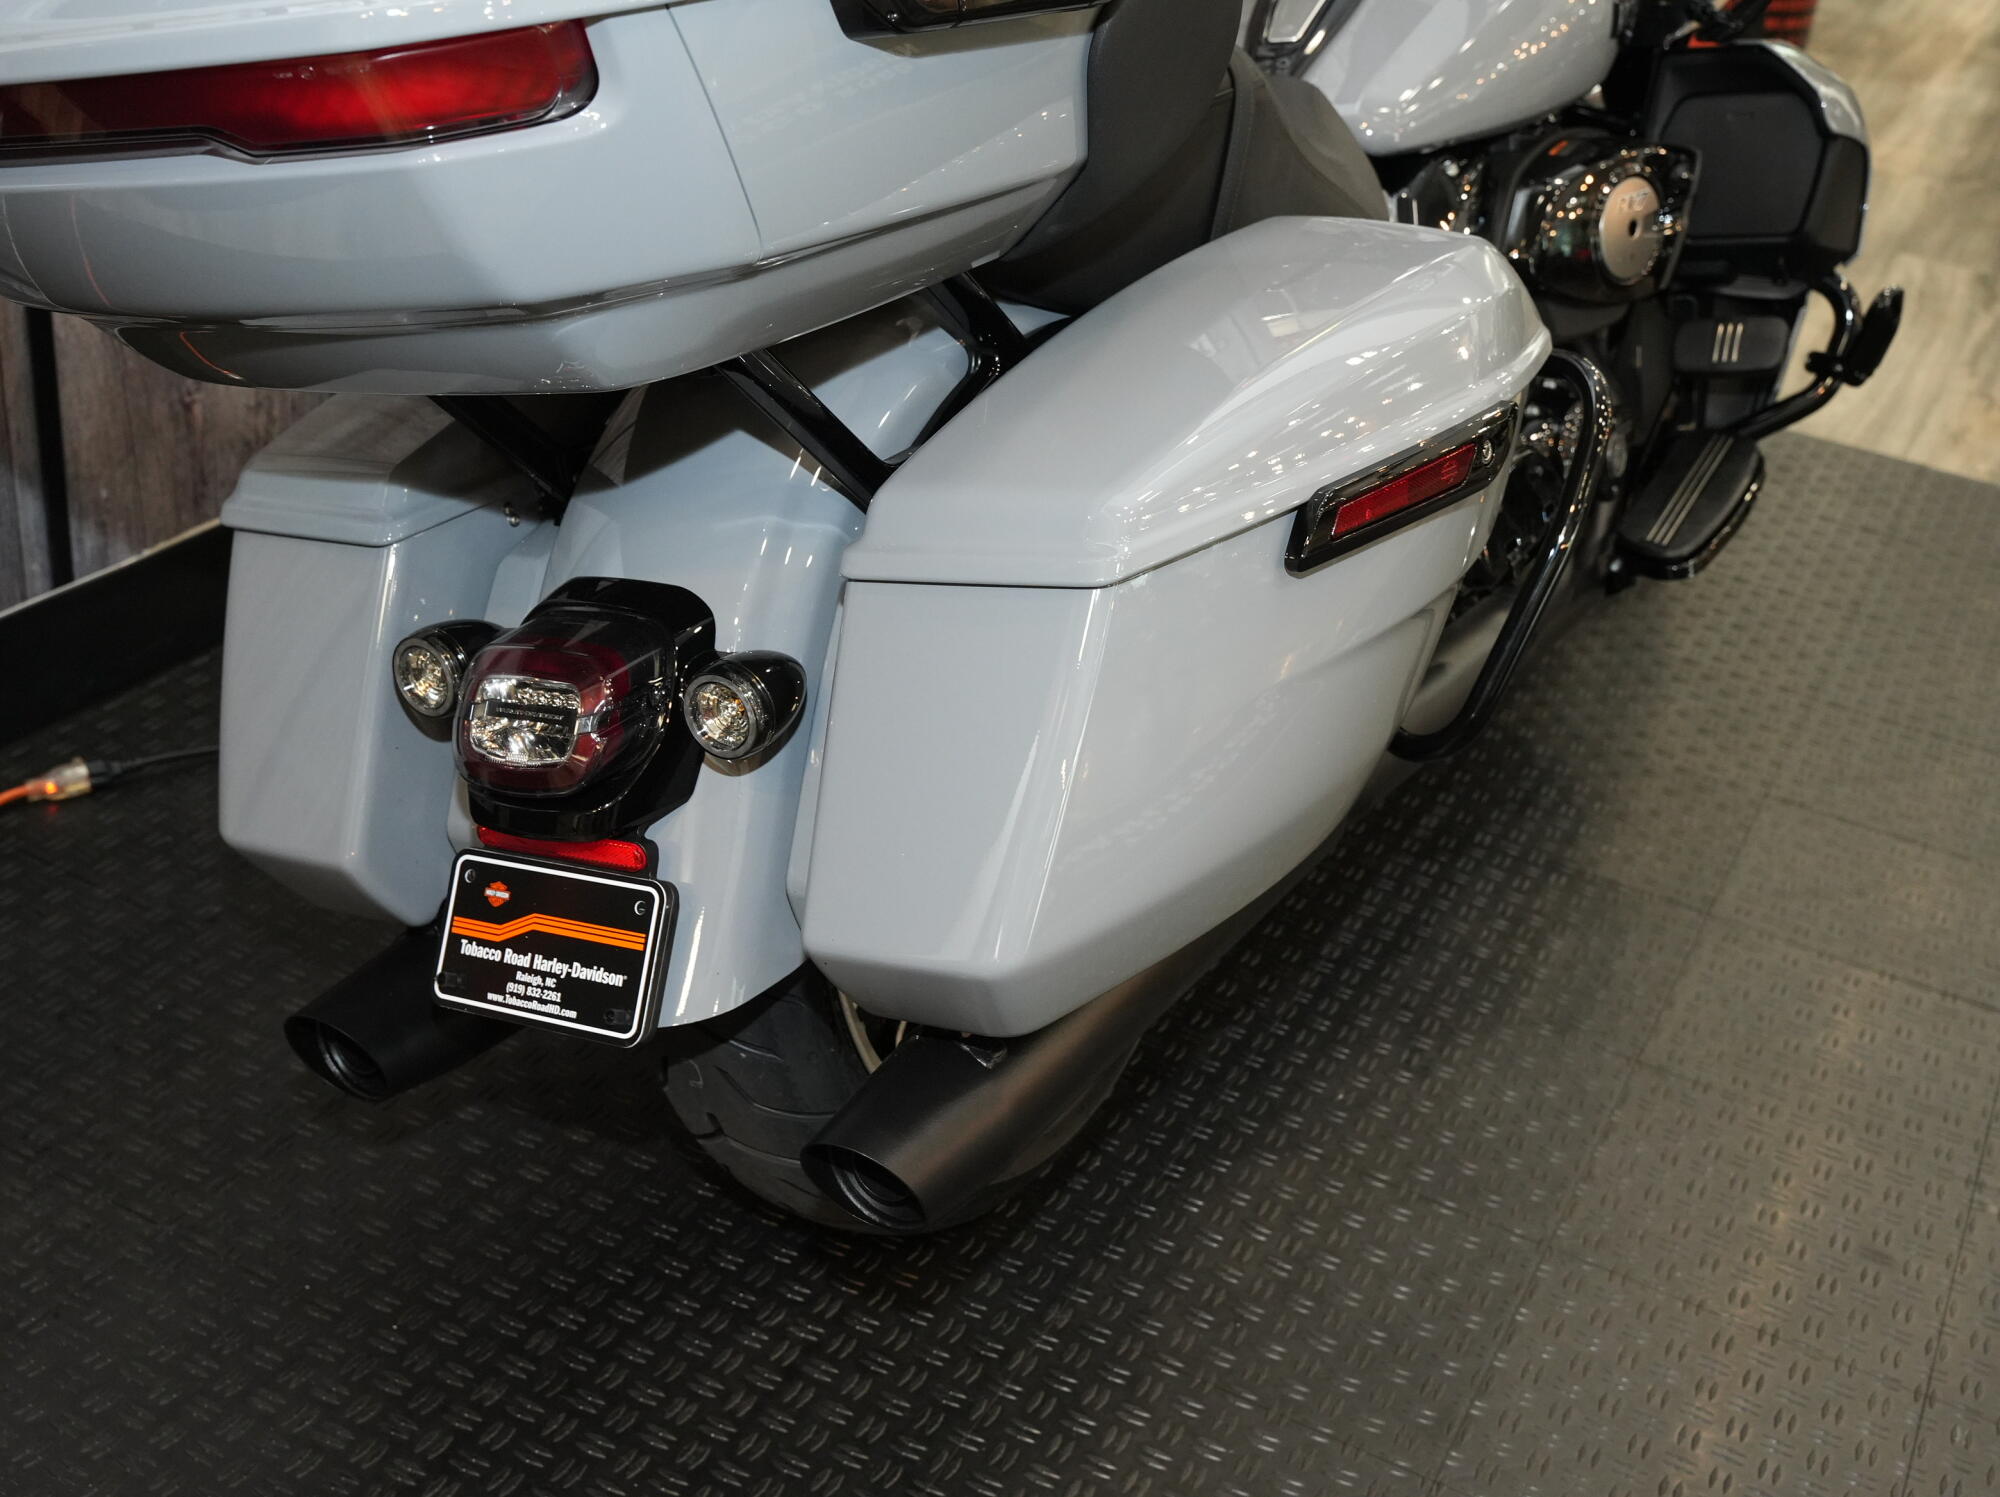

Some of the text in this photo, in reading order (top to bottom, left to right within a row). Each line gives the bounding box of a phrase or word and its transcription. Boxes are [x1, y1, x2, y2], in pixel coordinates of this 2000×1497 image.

[460, 939, 625, 987] Tobacco Road Harley-Davidson
[515, 971, 557, 989] Raleigh, NC
[506, 982, 561, 1002] (919) 832-2261
[487, 992, 577, 1018] www.TobaccoRoadHD.com
